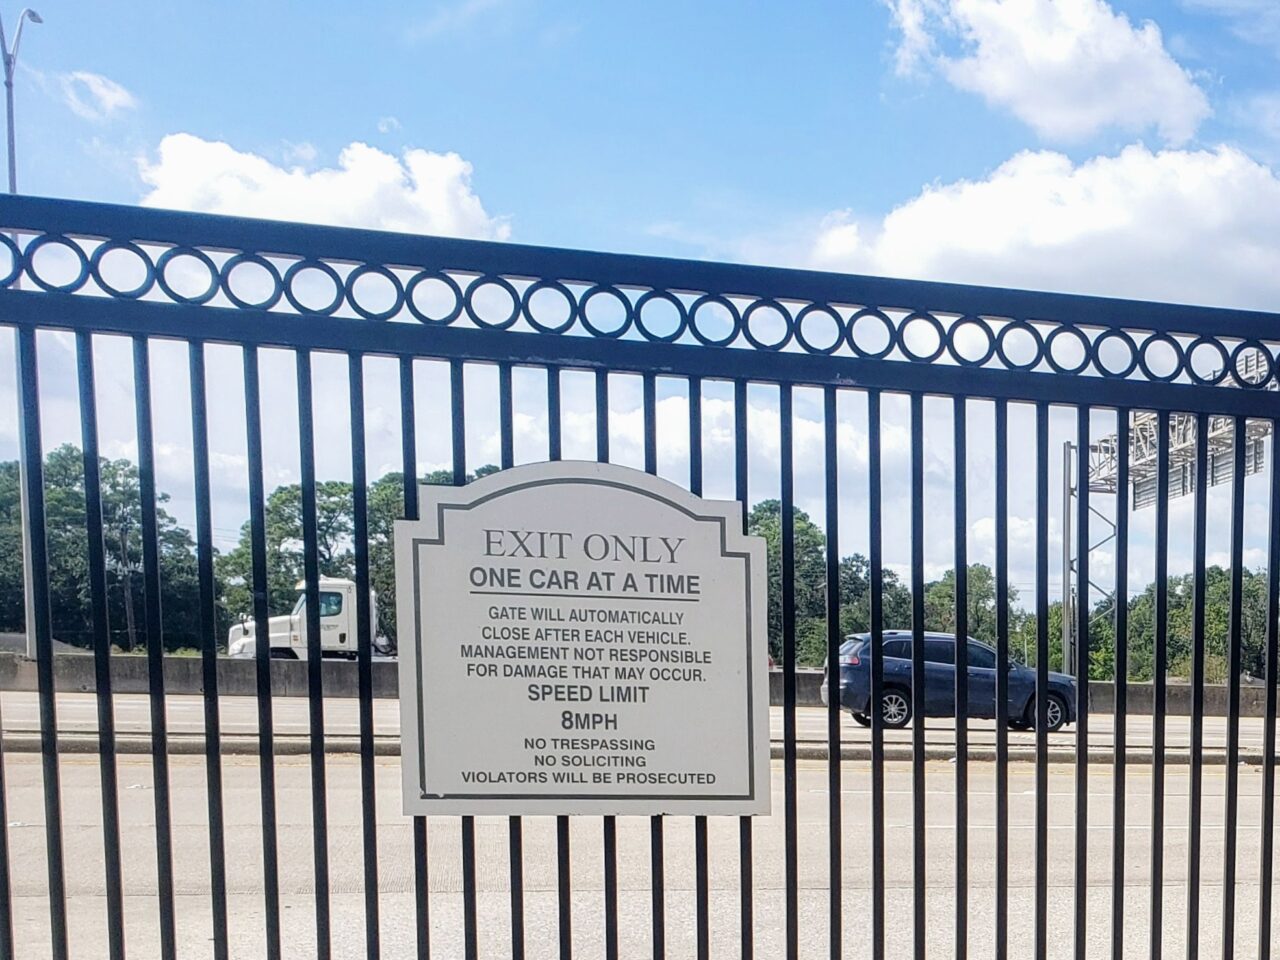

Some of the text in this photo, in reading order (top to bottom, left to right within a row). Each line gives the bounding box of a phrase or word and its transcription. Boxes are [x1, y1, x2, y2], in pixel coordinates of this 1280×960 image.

[482, 529, 687, 564] EXIT ONLY
[469, 566, 700, 595] ONE CAR AT A TIME
[488, 605, 684, 625] GATE WILL AUTOMATICALLY
[481, 626, 692, 646] CLOSE AFTER EACH VEHICLE.
[460, 644, 712, 664] MANAGEMENT NOT RESPONSIBLE
[466, 663, 707, 682] FOR DAMAGE THAT MAY OCCUR.
[527, 683, 650, 704] SPEED LIMIT
[524, 737, 656, 751] NO TRESPASSING
[534, 754, 647, 768] NO SOLICITING
[461, 771, 717, 785] VIOLATORS WILL BE PROSECUTED
